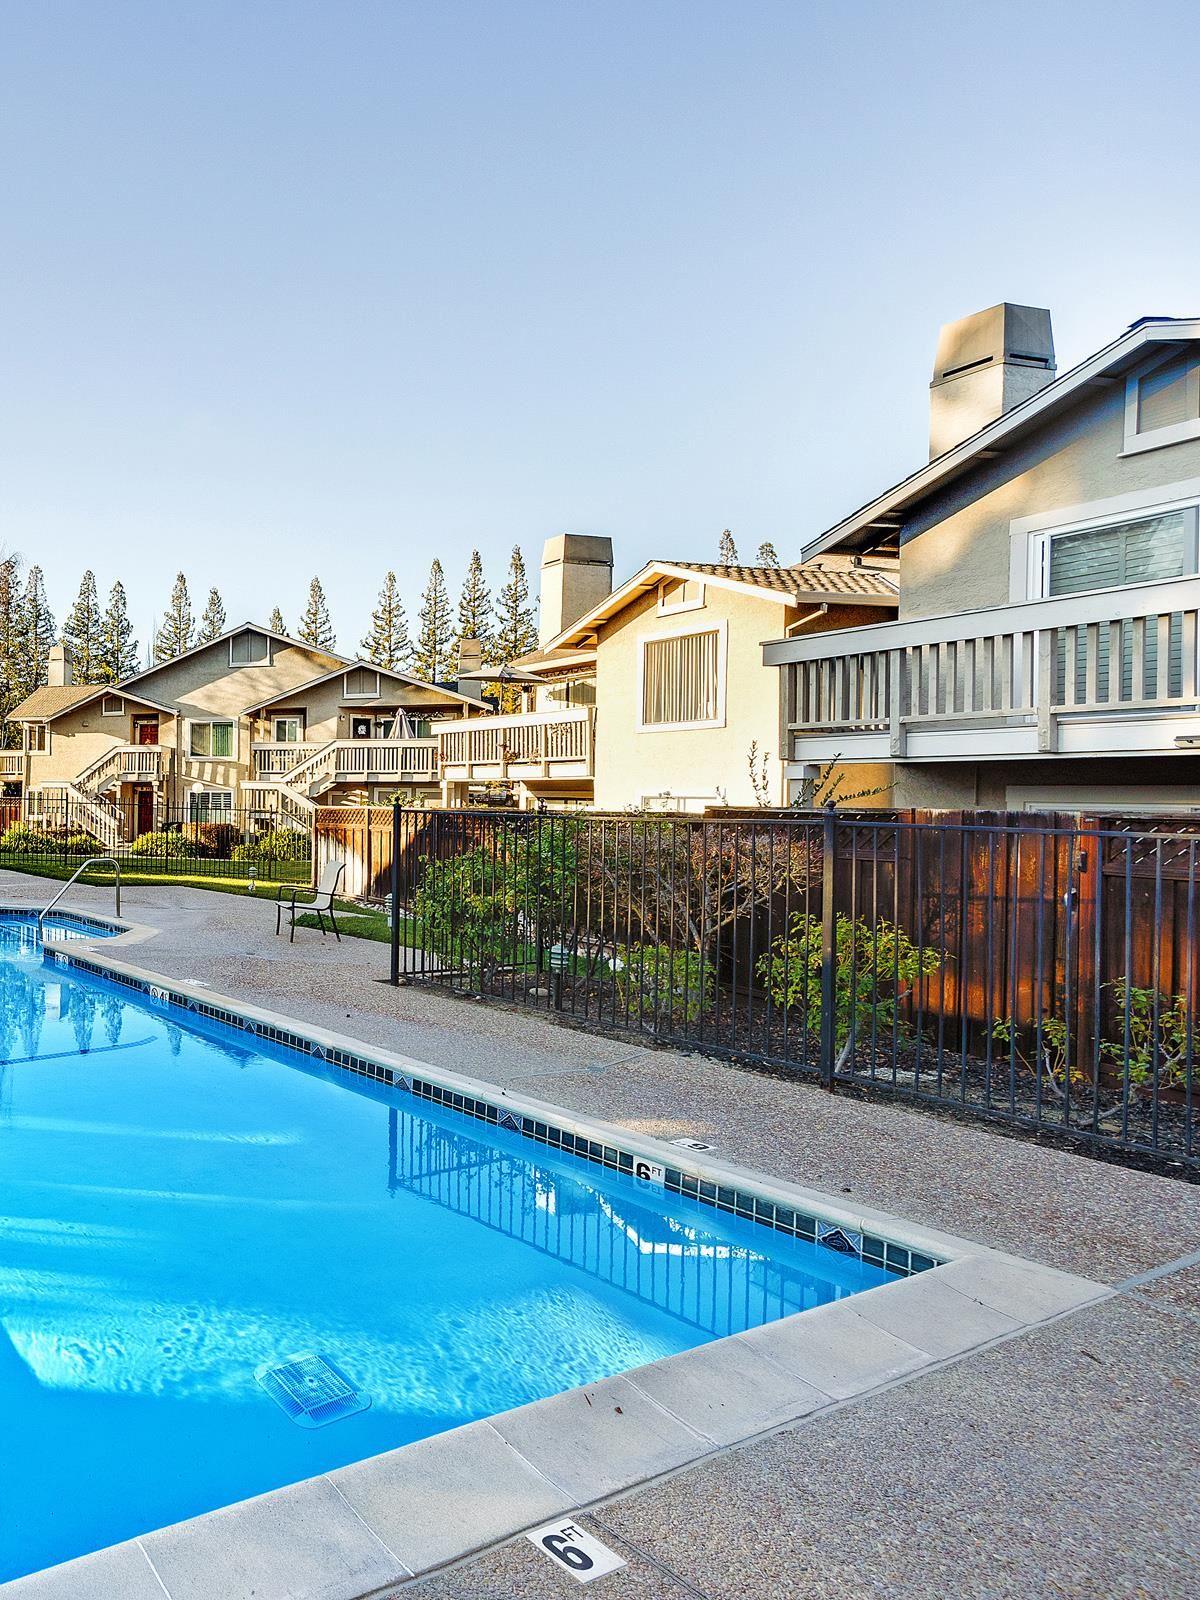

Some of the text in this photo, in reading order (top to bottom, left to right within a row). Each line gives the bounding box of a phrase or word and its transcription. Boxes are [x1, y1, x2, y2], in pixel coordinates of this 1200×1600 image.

[636, 1162, 662, 1180] 6 FT
[542, 1525, 594, 1571] 6 FT
